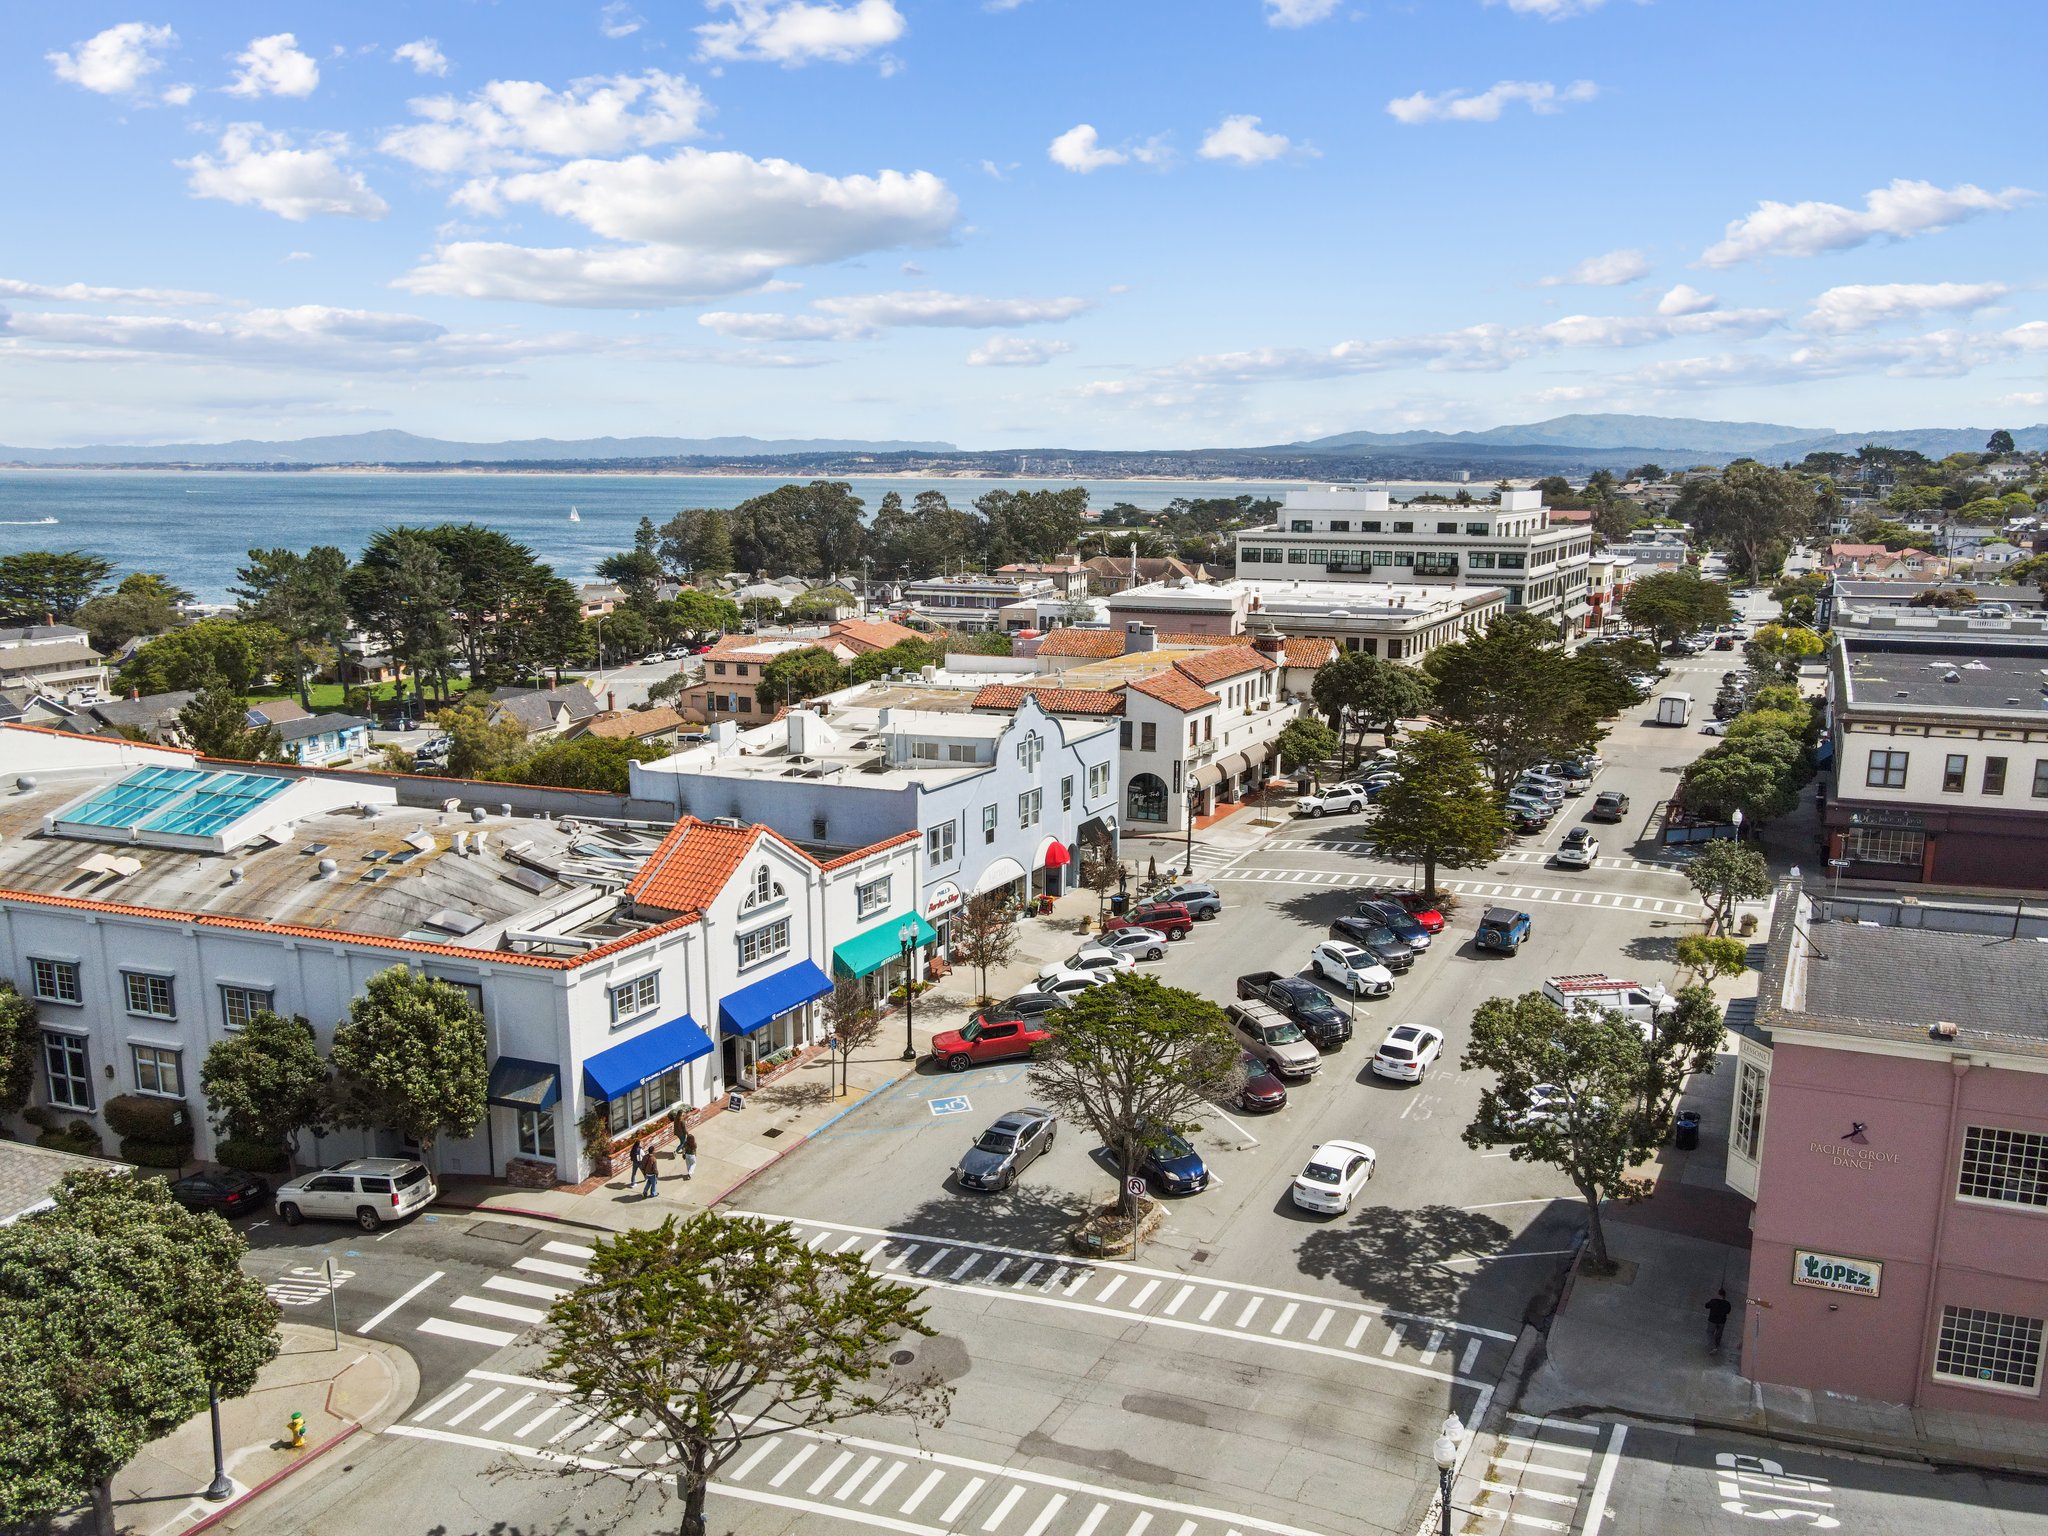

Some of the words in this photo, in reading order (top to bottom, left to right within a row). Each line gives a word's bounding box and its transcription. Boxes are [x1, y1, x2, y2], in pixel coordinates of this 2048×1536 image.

[928, 899, 947, 913] Barber
[947, 893, 959, 904] Shop
[1743, 1043, 1767, 1060] LESSONS
[1810, 1142, 1856, 1158] PACIFIC
[1859, 1149, 1900, 1163] GROVE
[1833, 1156, 1874, 1170] DANCE
[265, 1266, 357, 1306] STOP
[1798, 1277, 1828, 1287] LIQUORS
[1715, 1452, 1841, 1529] STOP
